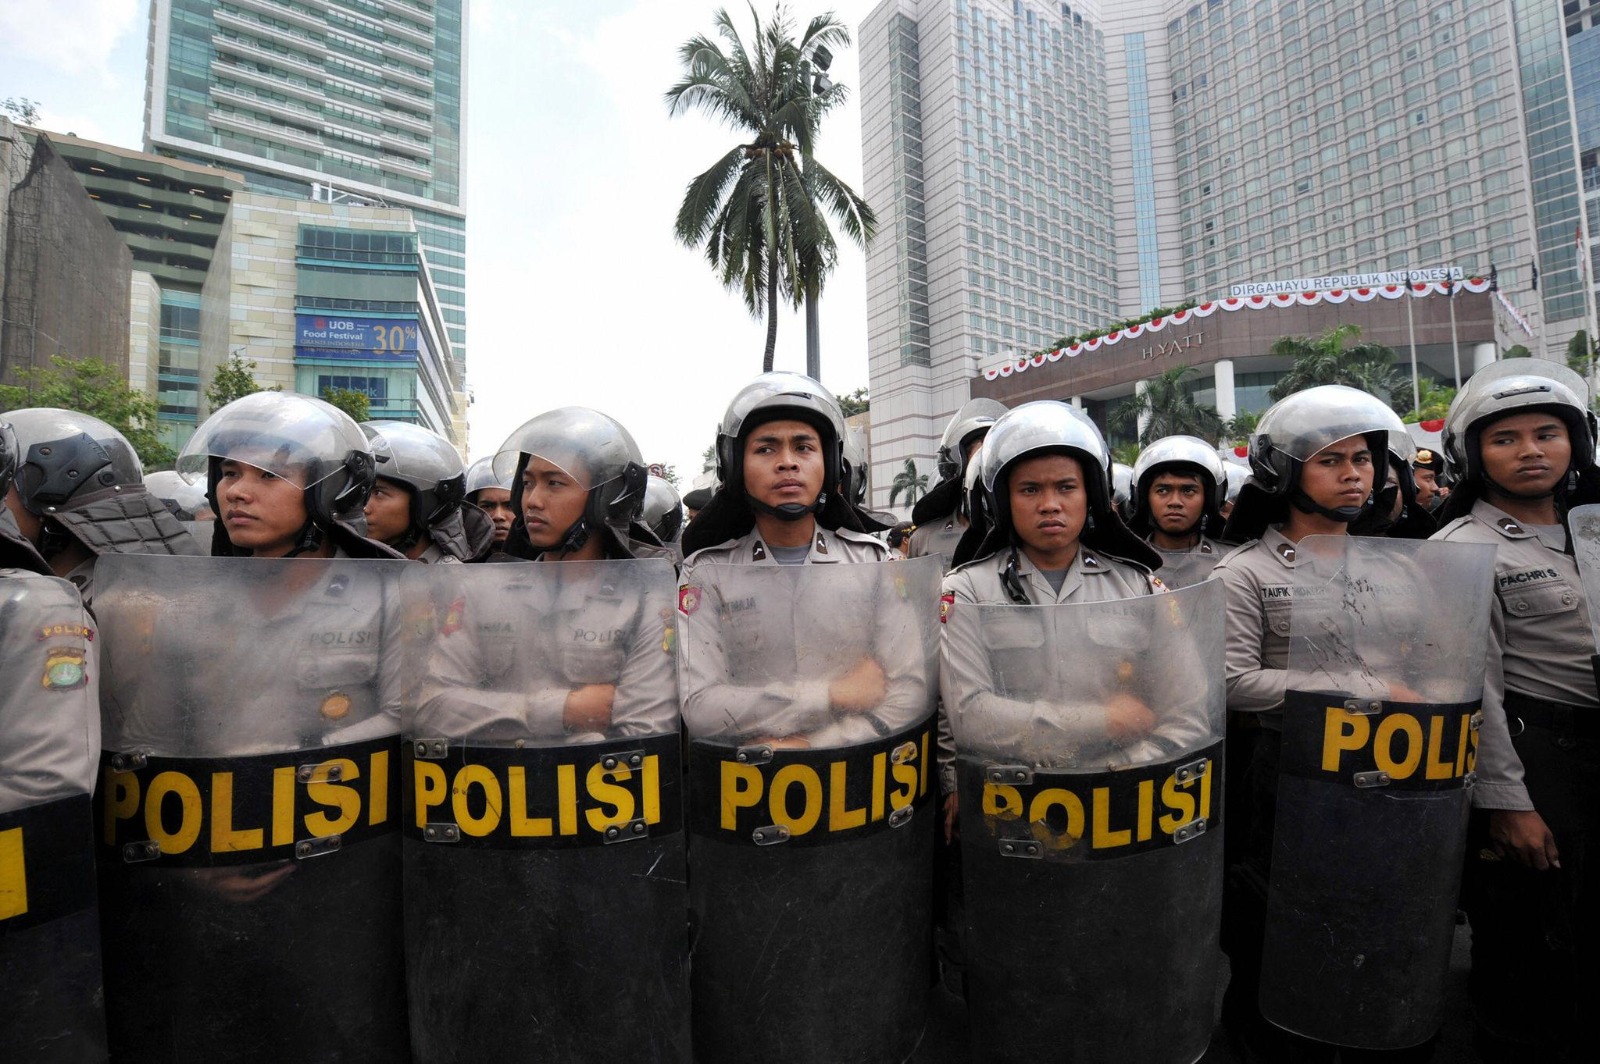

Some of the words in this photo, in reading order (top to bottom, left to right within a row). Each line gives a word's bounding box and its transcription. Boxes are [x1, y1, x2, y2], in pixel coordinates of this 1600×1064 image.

[1232, 279, 1309, 296] DIRGAHAYU
[1314, 274, 1381, 289] REPUBLIK
[1385, 267, 1461, 282] INDONESA
[303, 330, 327, 338] Food
[329, 331, 363, 341] Festival
[329, 321, 354, 330] UOB
[1142, 331, 1206, 360] HYATT
[1261, 587, 1291, 598] TAUFIK
[1500, 570, 1547, 587] FACHRI
[310, 631, 371, 645] POLISI
[414, 755, 660, 837] POLISI
[720, 731, 929, 836] POLISI
[104, 750, 389, 855] POLISI
[982, 760, 1212, 850] POLISI
